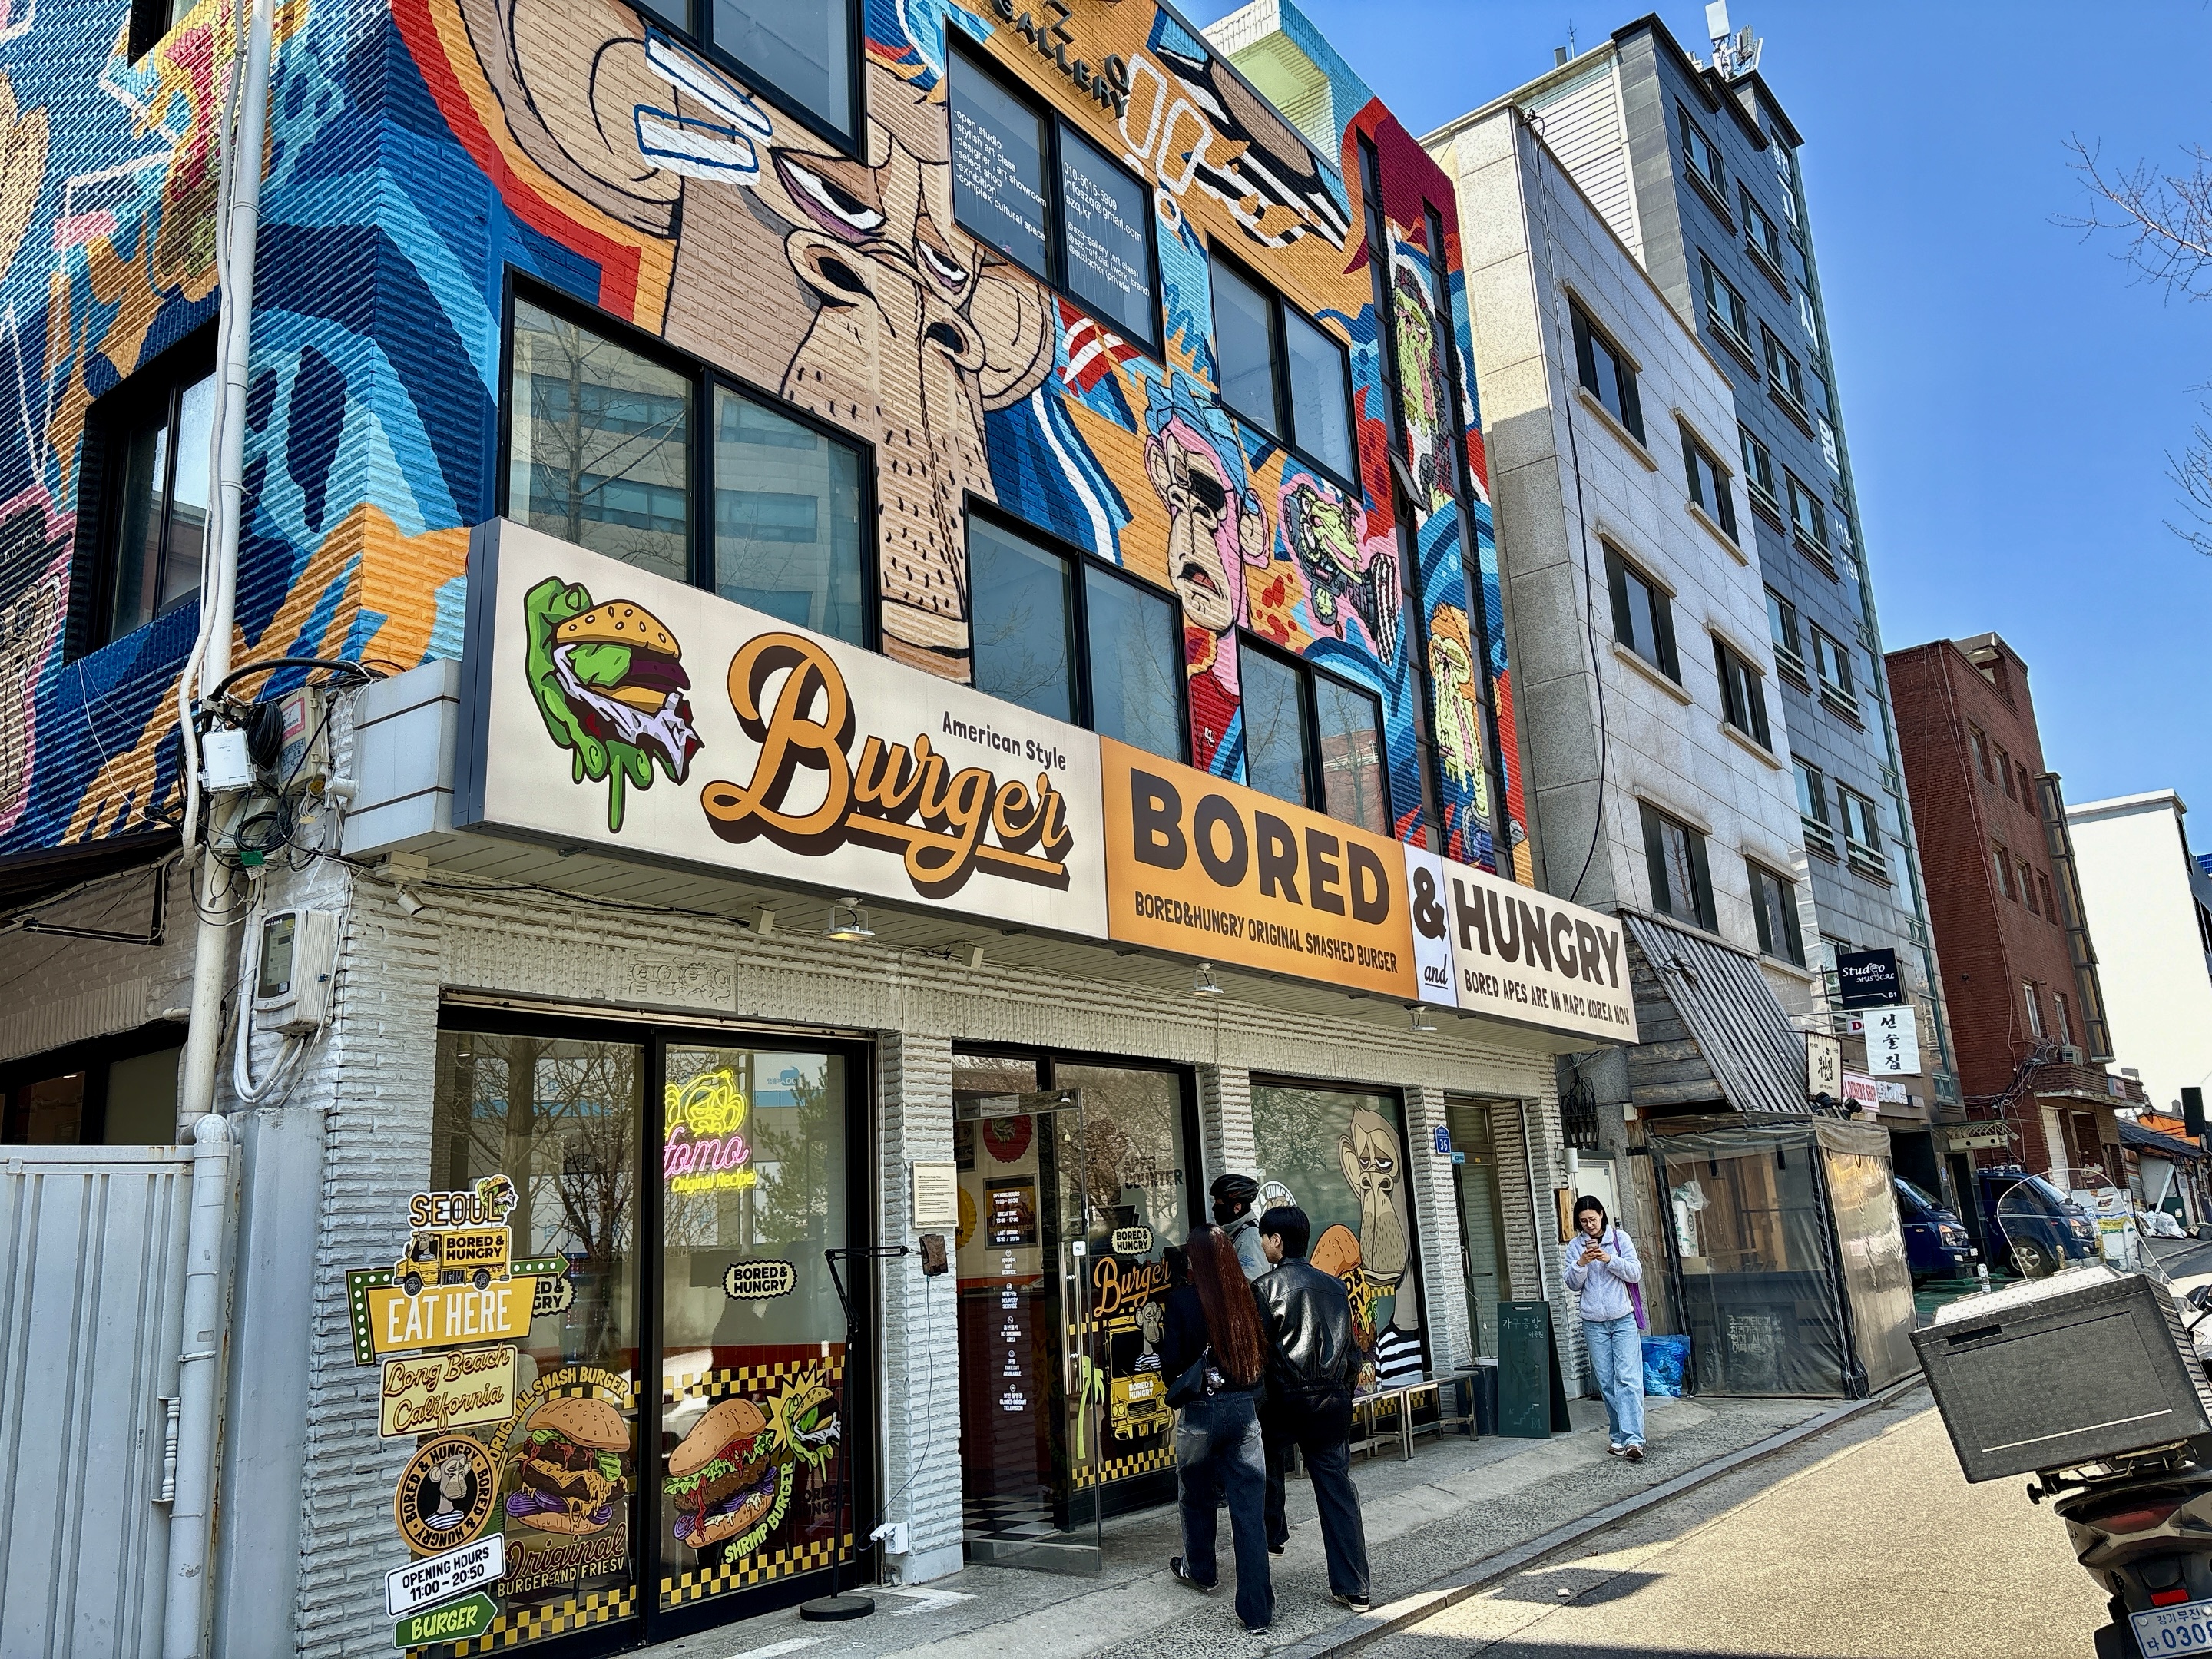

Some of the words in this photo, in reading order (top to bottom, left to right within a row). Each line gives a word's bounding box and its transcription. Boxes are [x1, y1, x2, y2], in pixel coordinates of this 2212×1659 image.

[992, 0, 1129, 119] GALLERY
[978, 126, 1002, 150] studio
[984, 144, 995, 157] art
[997, 154, 1017, 174] class
[983, 169, 1003, 188] shop
[996, 165, 1008, 181] art
[1008, 176, 1047, 208] showroom
[1064, 162, 1117, 211] 010-5015-5909
[994, 199, 1022, 225] cultural
[1024, 220, 1046, 242] space
[1065, 194, 1091, 220] szq.kr
[1105, 270, 1131, 294] (private)
[1130, 277, 1151, 297] brand)
[942, 709, 1022, 758] American
[1025, 739, 1068, 772] Style
[700, 631, 1075, 899] Burger
[1130, 767, 1390, 926] BORED
[1134, 890, 1245, 939] BORED&HUNGRY
[1247, 918, 1304, 954] ORIGINAL
[1305, 932, 1356, 965] SMASHED
[1357, 947, 1399, 975] BURGER
[1412, 866, 1447, 941] &
[1452, 878, 1620, 991] HUNGRY
[1424, 953, 1449, 987] and
[1463, 968, 1500, 999] BORED
[1503, 977, 1528, 1006] APES
[1531, 985, 1549, 1011] ARE
[1551, 988, 1561, 1012] IN
[1564, 991, 1585, 1018] MAPO
[1587, 996, 1614, 1024] KOREA
[1614, 1003, 1631, 1028] NOW
[1439, 1138, 1448, 1151] 36
[671, 1172, 714, 1194] Original
[716, 1167, 757, 1190] Recipe
[1124, 1167, 1184, 1190] COUNTER
[409, 1191, 504, 1227] SEOUL
[1260, 1191, 1267, 1205] &
[446, 1236, 494, 1249] BORED
[495, 1234, 505, 1247] &
[1116, 1230, 1142, 1241] BORED
[1142, 1229, 1148, 1239] &
[1117, 1239, 1148, 1251] HUNGRY
[445, 1247, 504, 1261] HUNGRY
[734, 1267, 778, 1280] BORED
[780, 1266, 788, 1278] &
[734, 1279, 787, 1294] HUNGRY
[1094, 1257, 1172, 1318] Burger
[387, 1293, 439, 1344] EAT
[445, 1289, 513, 1339] HERE
[1502, 1316, 1541, 1330] 가구공방
[384, 1363, 443, 1397] Long
[443, 1342, 510, 1382] Beach
[532, 1366, 576, 1396] SMASH
[579, 1366, 629, 1399] BURGER
[1128, 1380, 1149, 1392] BORED
[393, 1382, 505, 1435] California
[1129, 1388, 1154, 1399] HUNGRY
[404, 1471, 421, 1525] BORED
[417, 1460, 431, 1472] &
[430, 1443, 479, 1466] HUNGRY
[473, 1467, 489, 1517] BORED
[464, 1518, 477, 1530] &
[724, 1522, 768, 1564] SHRIMP
[767, 1461, 793, 1531] BURGER
[414, 1525, 465, 1548] HUNGRY
[498, 1522, 626, 1582] Original
[402, 1559, 451, 1589] OPENING
[453, 1546, 490, 1571] HOURS
[409, 1581, 440, 1602] 11:00
[452, 1563, 485, 1585] 20:50
[498, 1573, 549, 1598] BURGER
[553, 1567, 577, 1585] AND
[411, 1604, 478, 1641] BURGER
